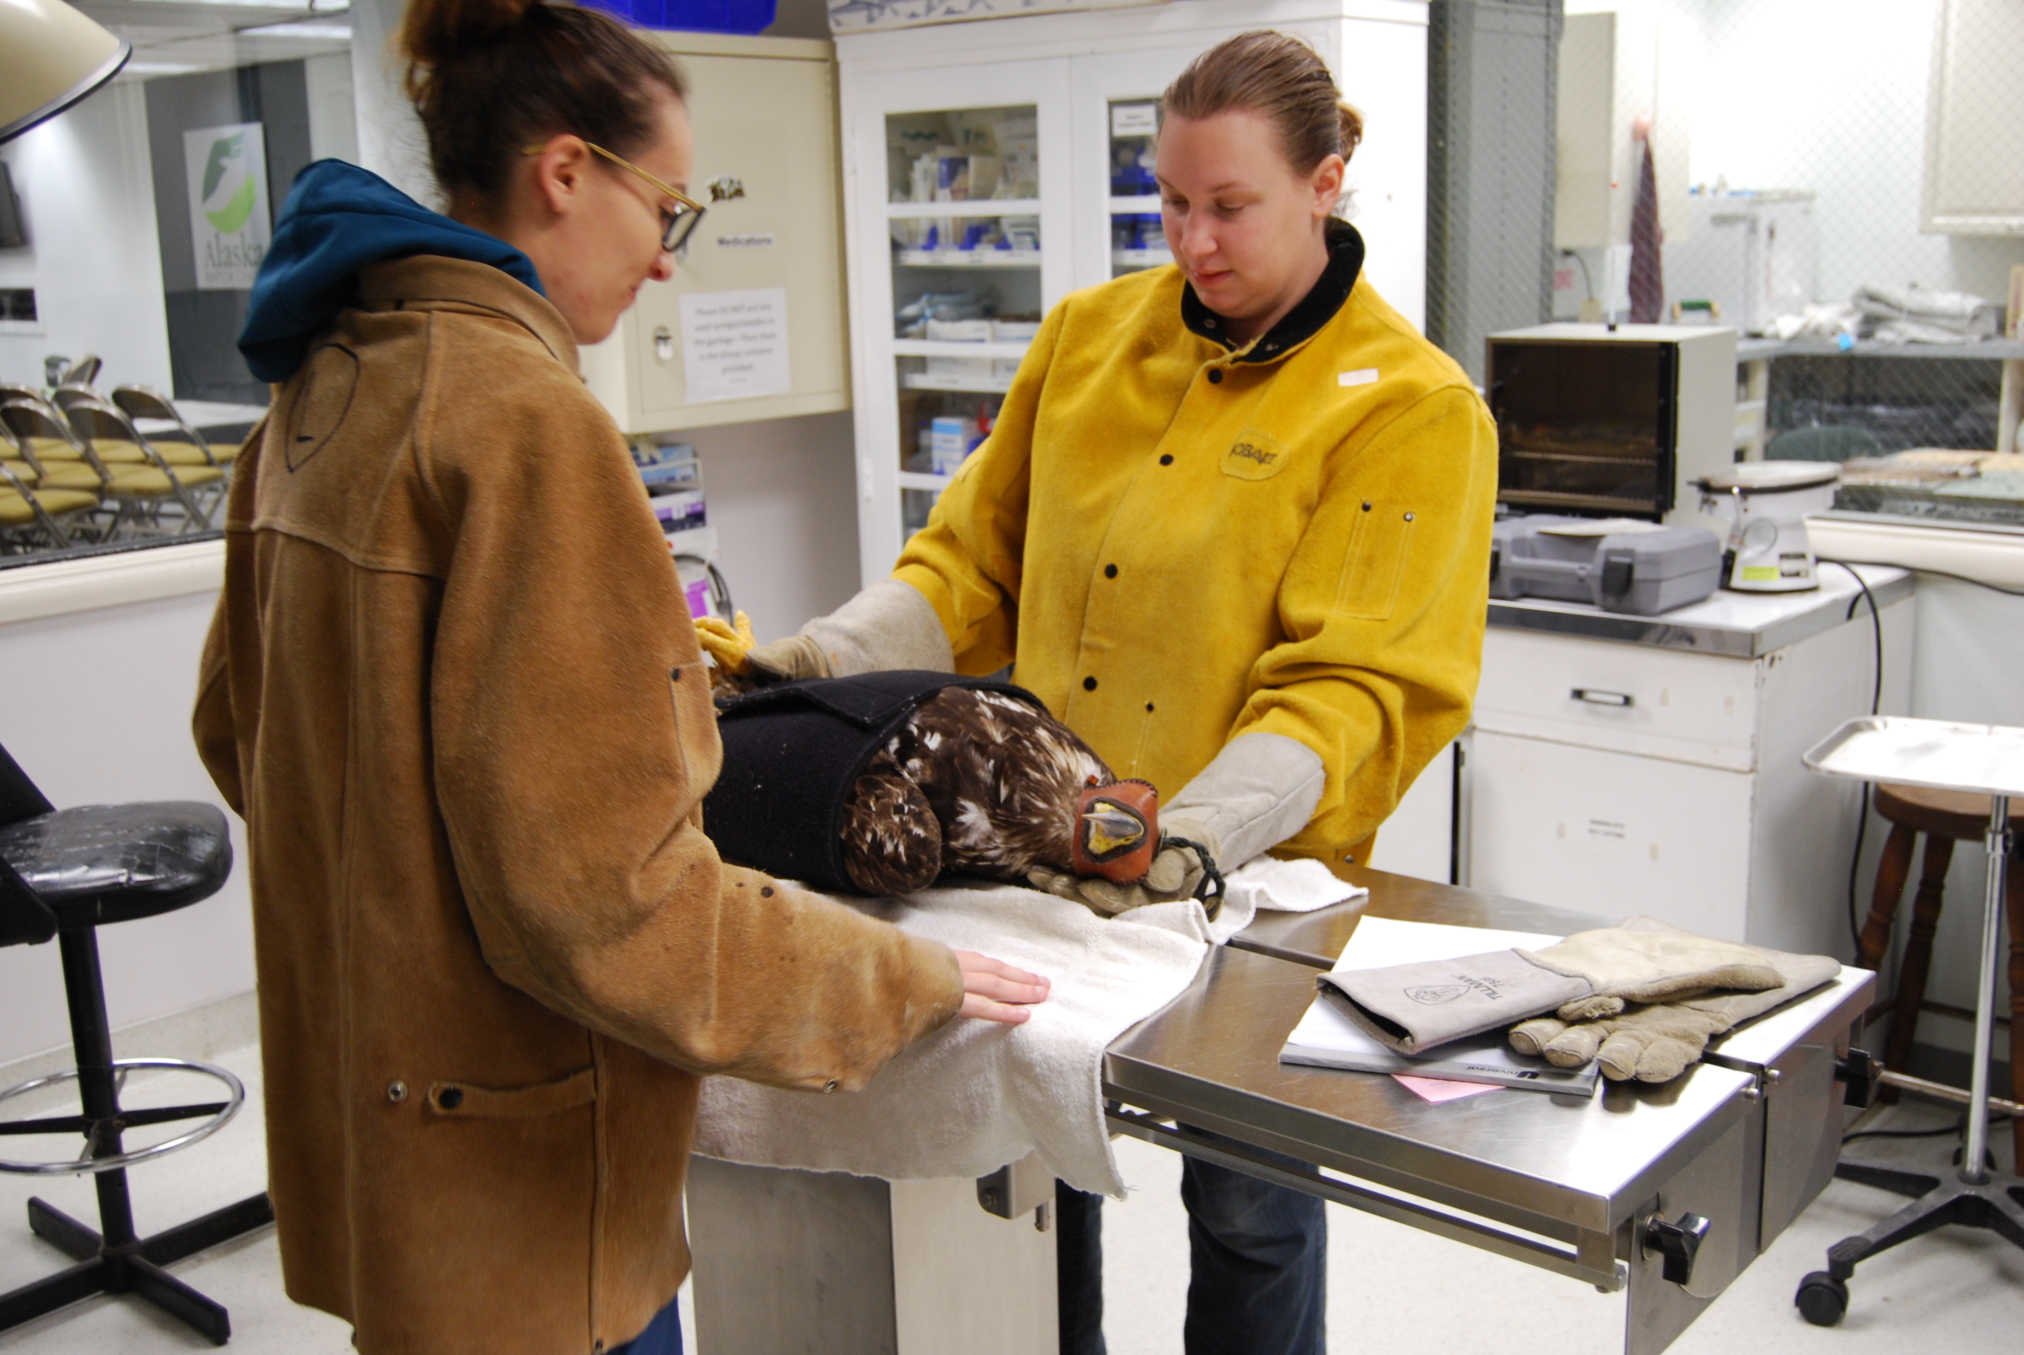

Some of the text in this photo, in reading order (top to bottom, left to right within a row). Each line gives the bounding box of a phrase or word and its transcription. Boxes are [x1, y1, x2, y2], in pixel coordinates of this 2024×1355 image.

[204, 231, 263, 268] Alaska
[717, 236, 772, 246] Medications
[1451, 974, 1503, 1001] TILLMAN
[1466, 1065, 1540, 1080] Universal
